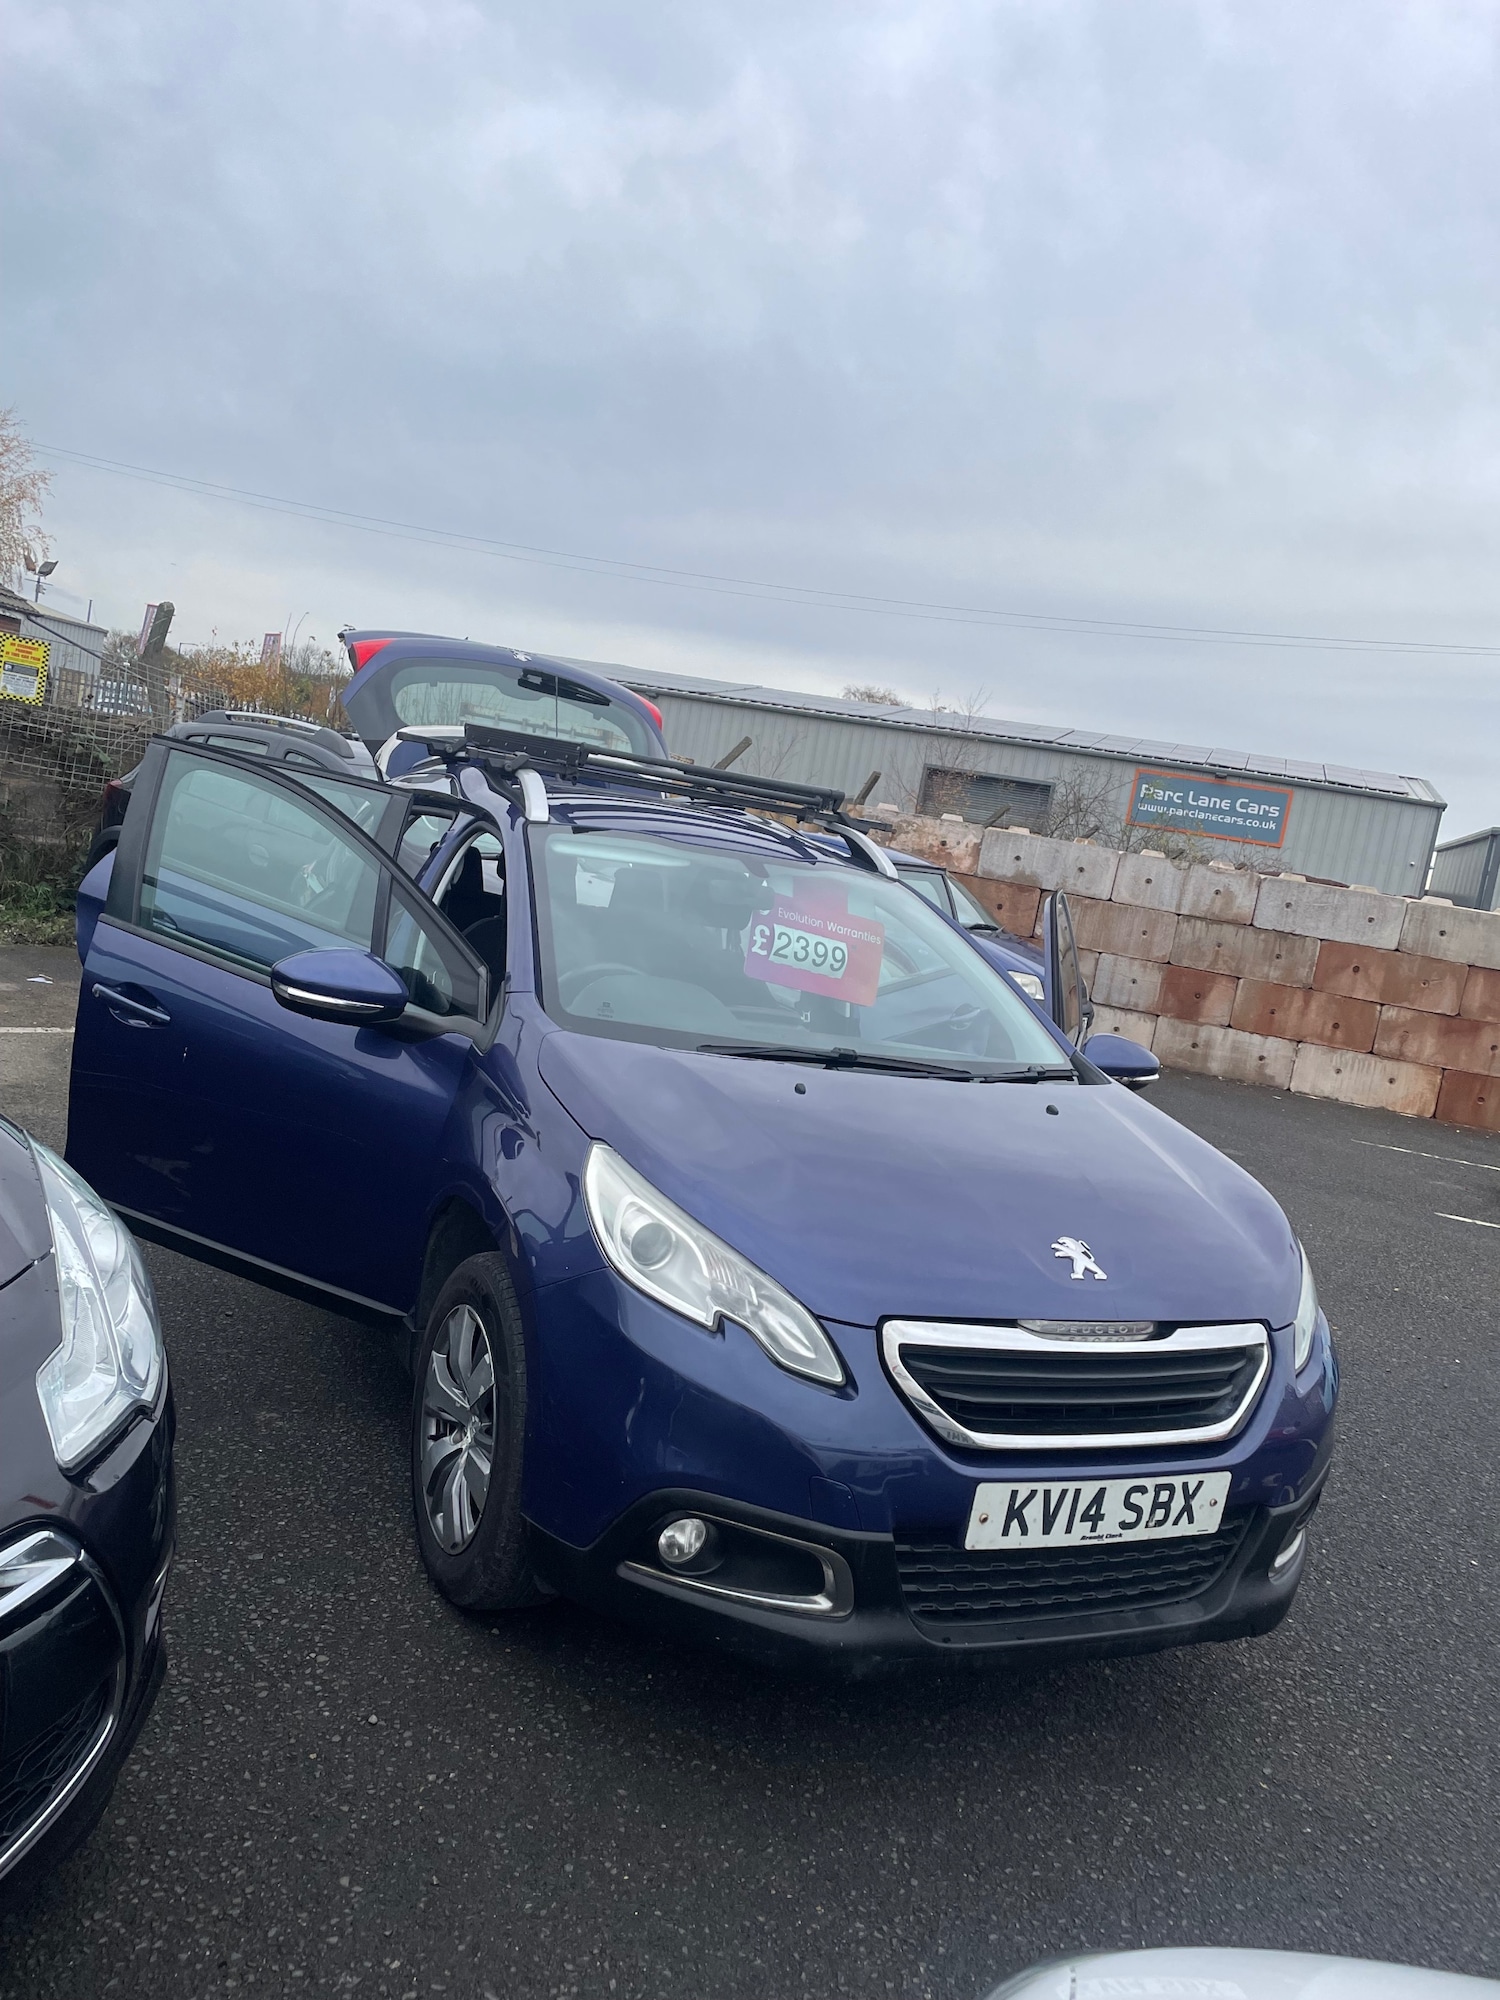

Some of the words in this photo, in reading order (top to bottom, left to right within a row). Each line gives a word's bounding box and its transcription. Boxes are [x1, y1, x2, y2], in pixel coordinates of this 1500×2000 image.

[1138, 802, 1277, 830] www.parclanecars.co.uk
[1140, 784, 1183, 804] Parc
[1188, 791, 1231, 810] Lane
[1236, 798, 1280, 818] Cars
[778, 907, 824, 929] Evolution
[827, 920, 882, 945] Warranties
[751, 924, 847, 972] £2399
[1001, 1487, 1107, 1537] KV14
[1118, 1480, 1205, 1531] SBX
